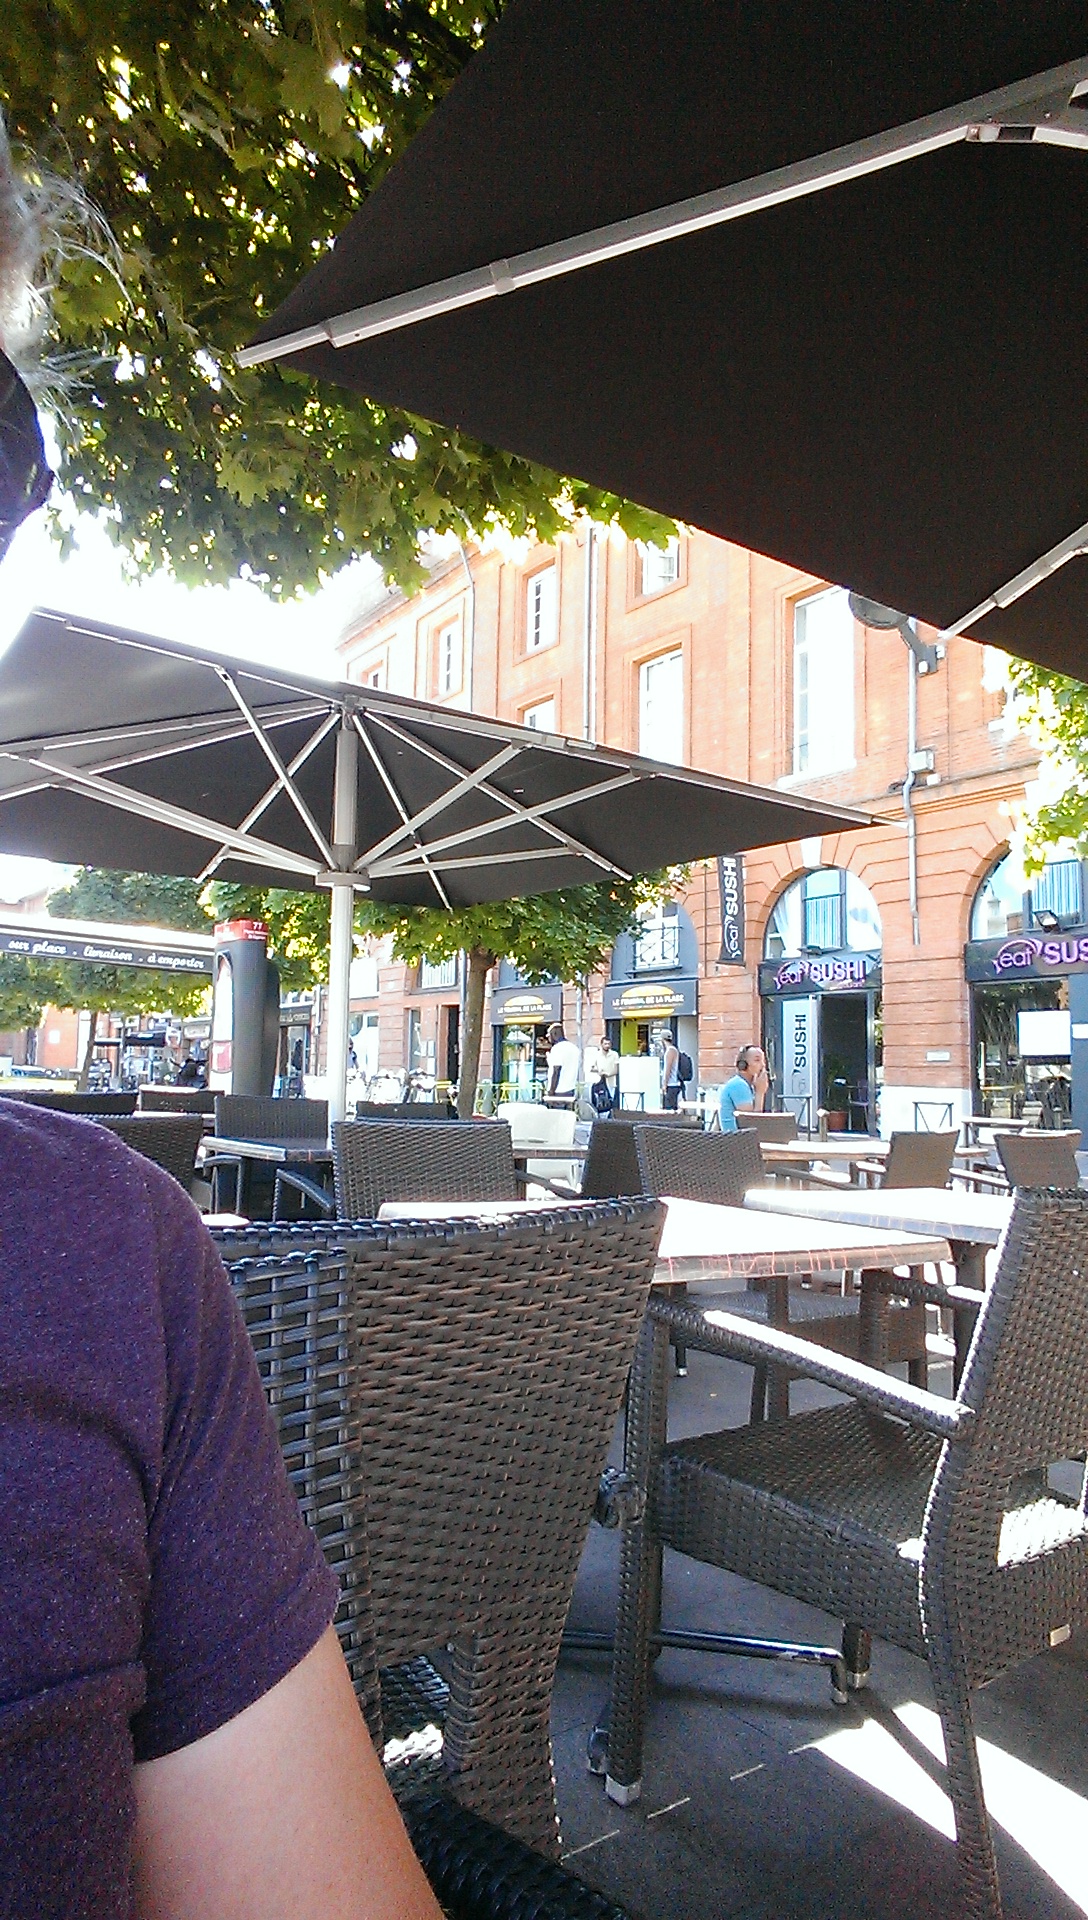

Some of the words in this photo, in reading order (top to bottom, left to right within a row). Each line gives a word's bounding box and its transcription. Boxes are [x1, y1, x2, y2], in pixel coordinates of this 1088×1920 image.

[722, 857, 739, 916] SUSHI
[8, 940, 30, 951] sur
[31, 940, 67, 955] place
[83, 945, 133, 962] livraison
[157, 956, 205, 969] emporter
[999, 947, 1033, 968] eat
[810, 959, 866, 982] SUSHI
[794, 1014, 807, 1068] SUSHI
